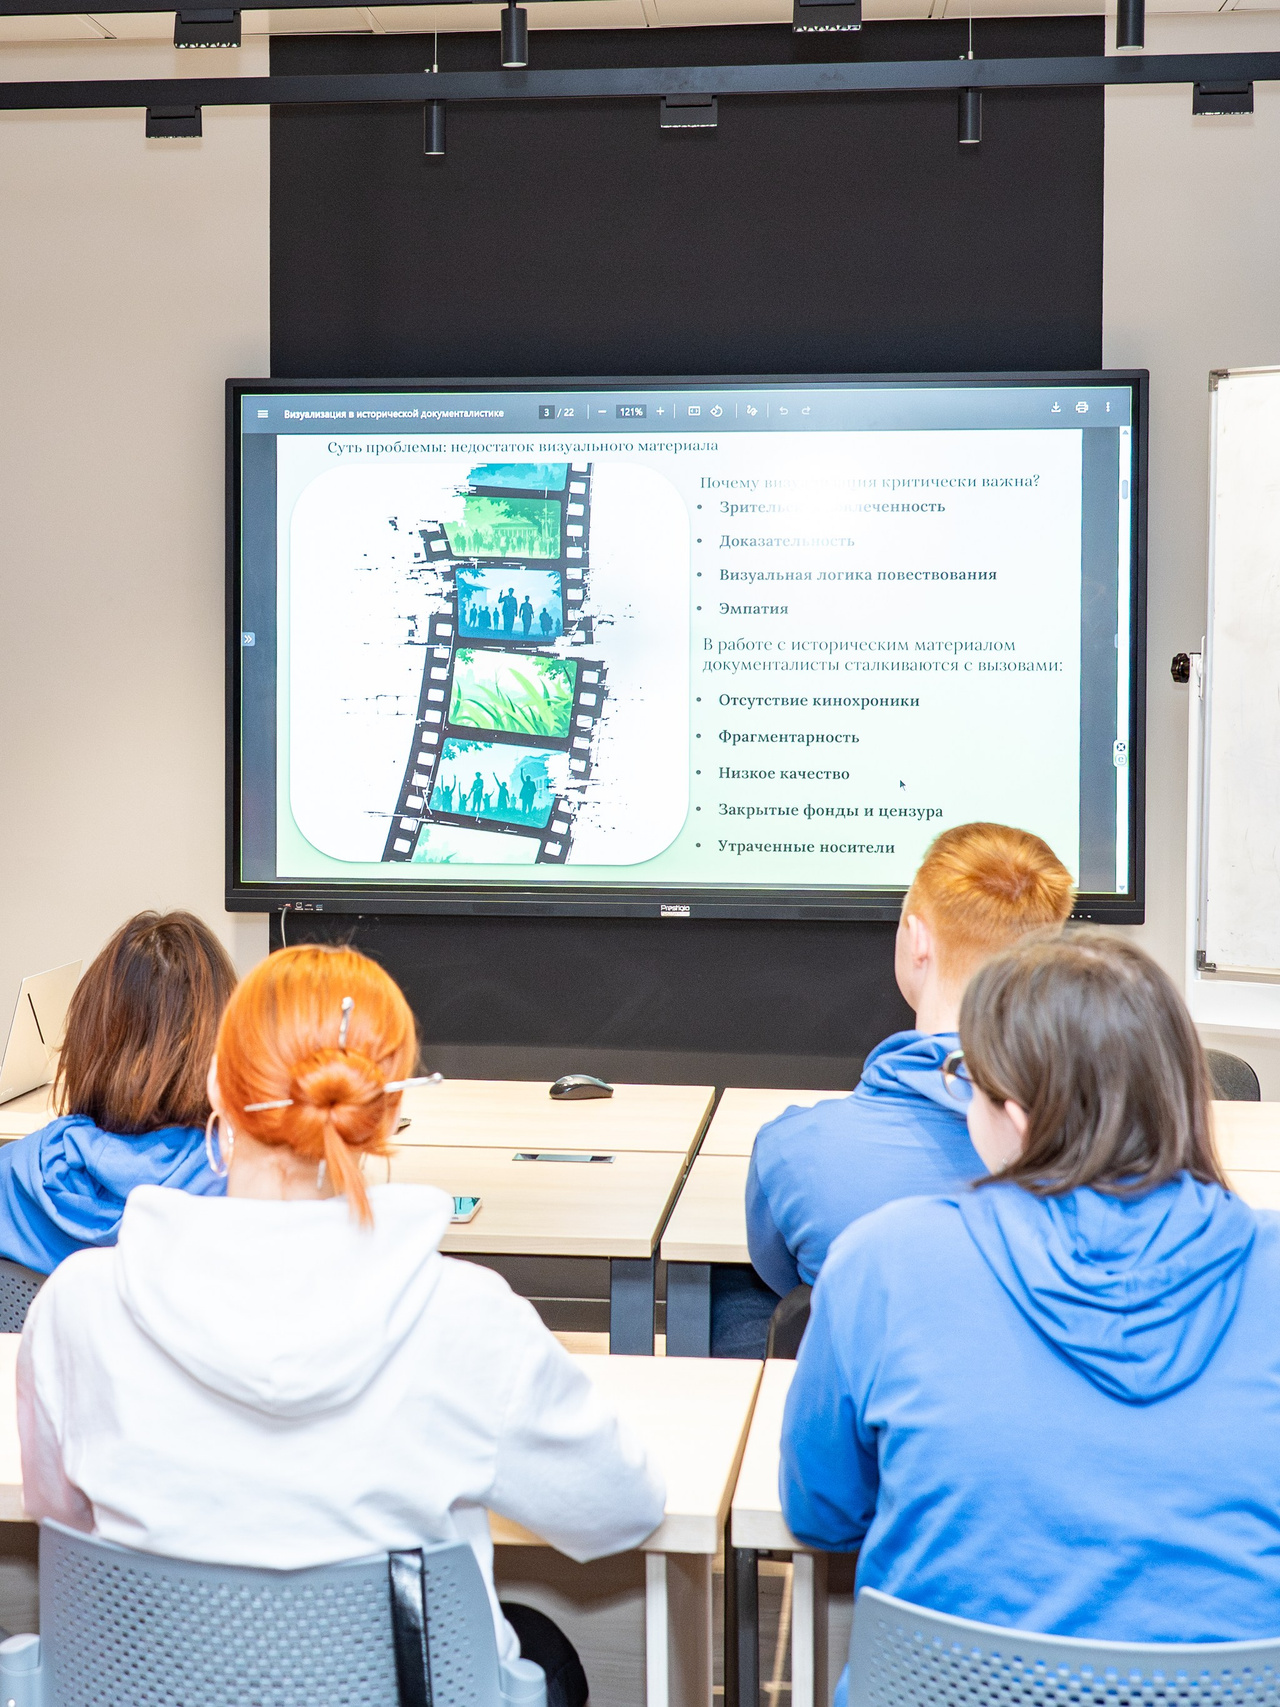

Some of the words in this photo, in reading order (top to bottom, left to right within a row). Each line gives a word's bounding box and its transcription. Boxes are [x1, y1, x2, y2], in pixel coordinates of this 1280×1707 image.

[283, 408, 347, 421] Визуализация
[348, 410, 355, 419] в
[356, 408, 419, 421] исторической
[420, 408, 505, 421] документалистике
[544, 408, 550, 417] 3
[563, 407, 575, 417] 22
[620, 407, 643, 417] 121%
[327, 441, 363, 457] Суть
[366, 440, 447, 457] проблемы:
[451, 442, 535, 455] недостаток
[538, 441, 634, 456] визуального
[638, 441, 719, 456] материала
[699, 476, 760, 493] Почему
[881, 476, 977, 492] критически
[981, 473, 1041, 488] важна?
[718, 534, 856, 550] Доказательность
[719, 568, 812, 585] Визуальная
[816, 570, 873, 582] логика
[877, 570, 998, 582] повествования
[719, 602, 789, 616] Эмпатия
[703, 637, 713, 652] В
[717, 636, 773, 655] работе
[777, 640, 786, 652] с
[791, 639, 909, 655] историческим
[914, 639, 1016, 656] материалом
[702, 660, 840, 676] документалисты
[844, 661, 959, 673] сталкиваются
[963, 661, 973, 673] с
[978, 660, 1063, 673] вызовами:
[718, 693, 809, 711] Отсутствие
[812, 696, 920, 711] кинохроники
[718, 729, 860, 747] Фрагментарность
[718, 766, 776, 780] Низкое
[779, 769, 850, 781] качество
[718, 802, 799, 820] Закрытые
[802, 802, 859, 821] фонды
[863, 807, 874, 817] и
[878, 806, 944, 822] цензура
[717, 839, 815, 856] Утраченные
[819, 842, 895, 855] носители
